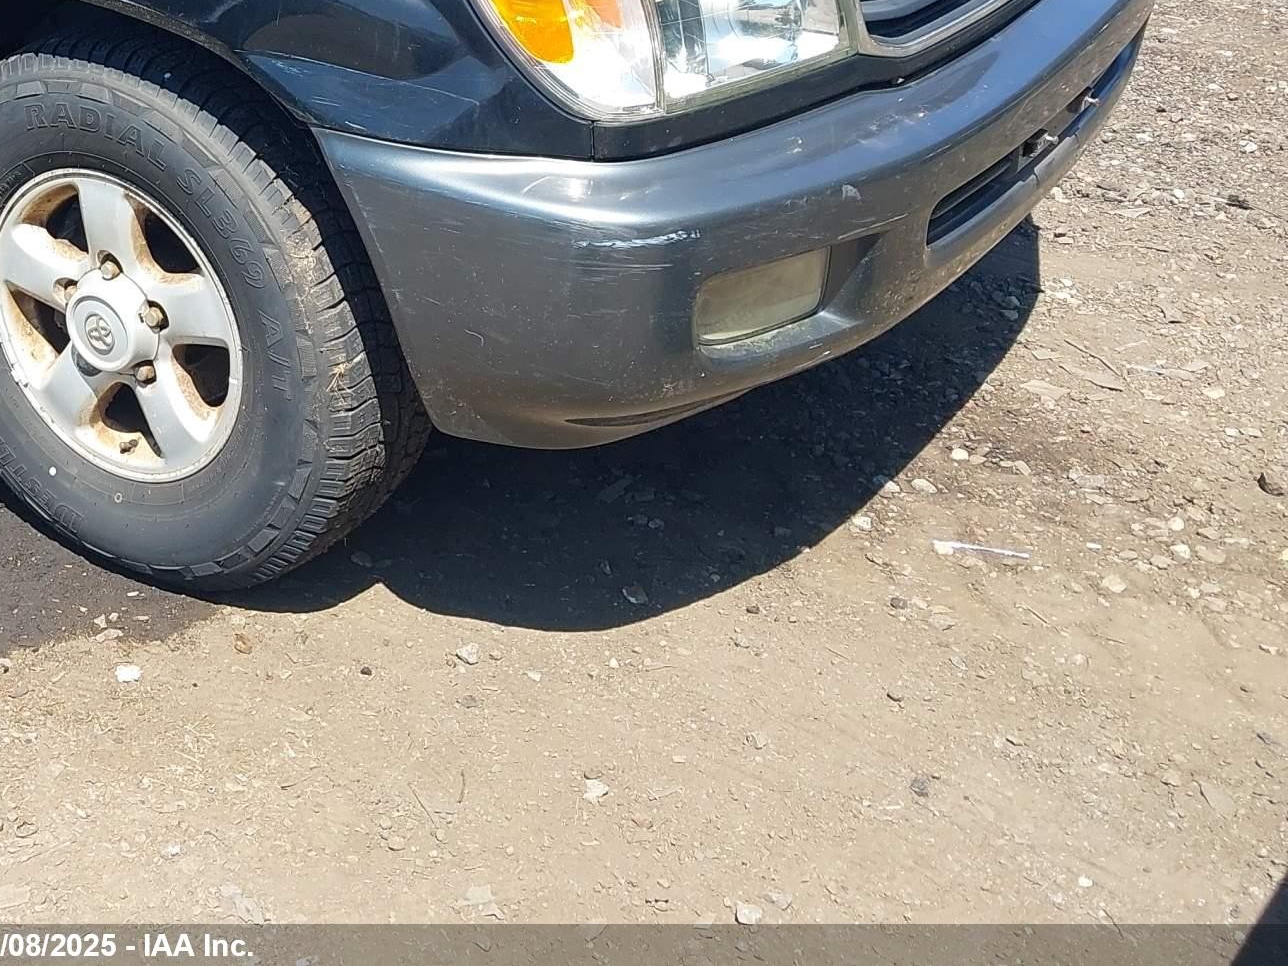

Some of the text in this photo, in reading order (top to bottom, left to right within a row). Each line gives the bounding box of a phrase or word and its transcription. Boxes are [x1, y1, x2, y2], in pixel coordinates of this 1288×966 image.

[23, 102, 292, 402] RADIAL SL369 A/T
